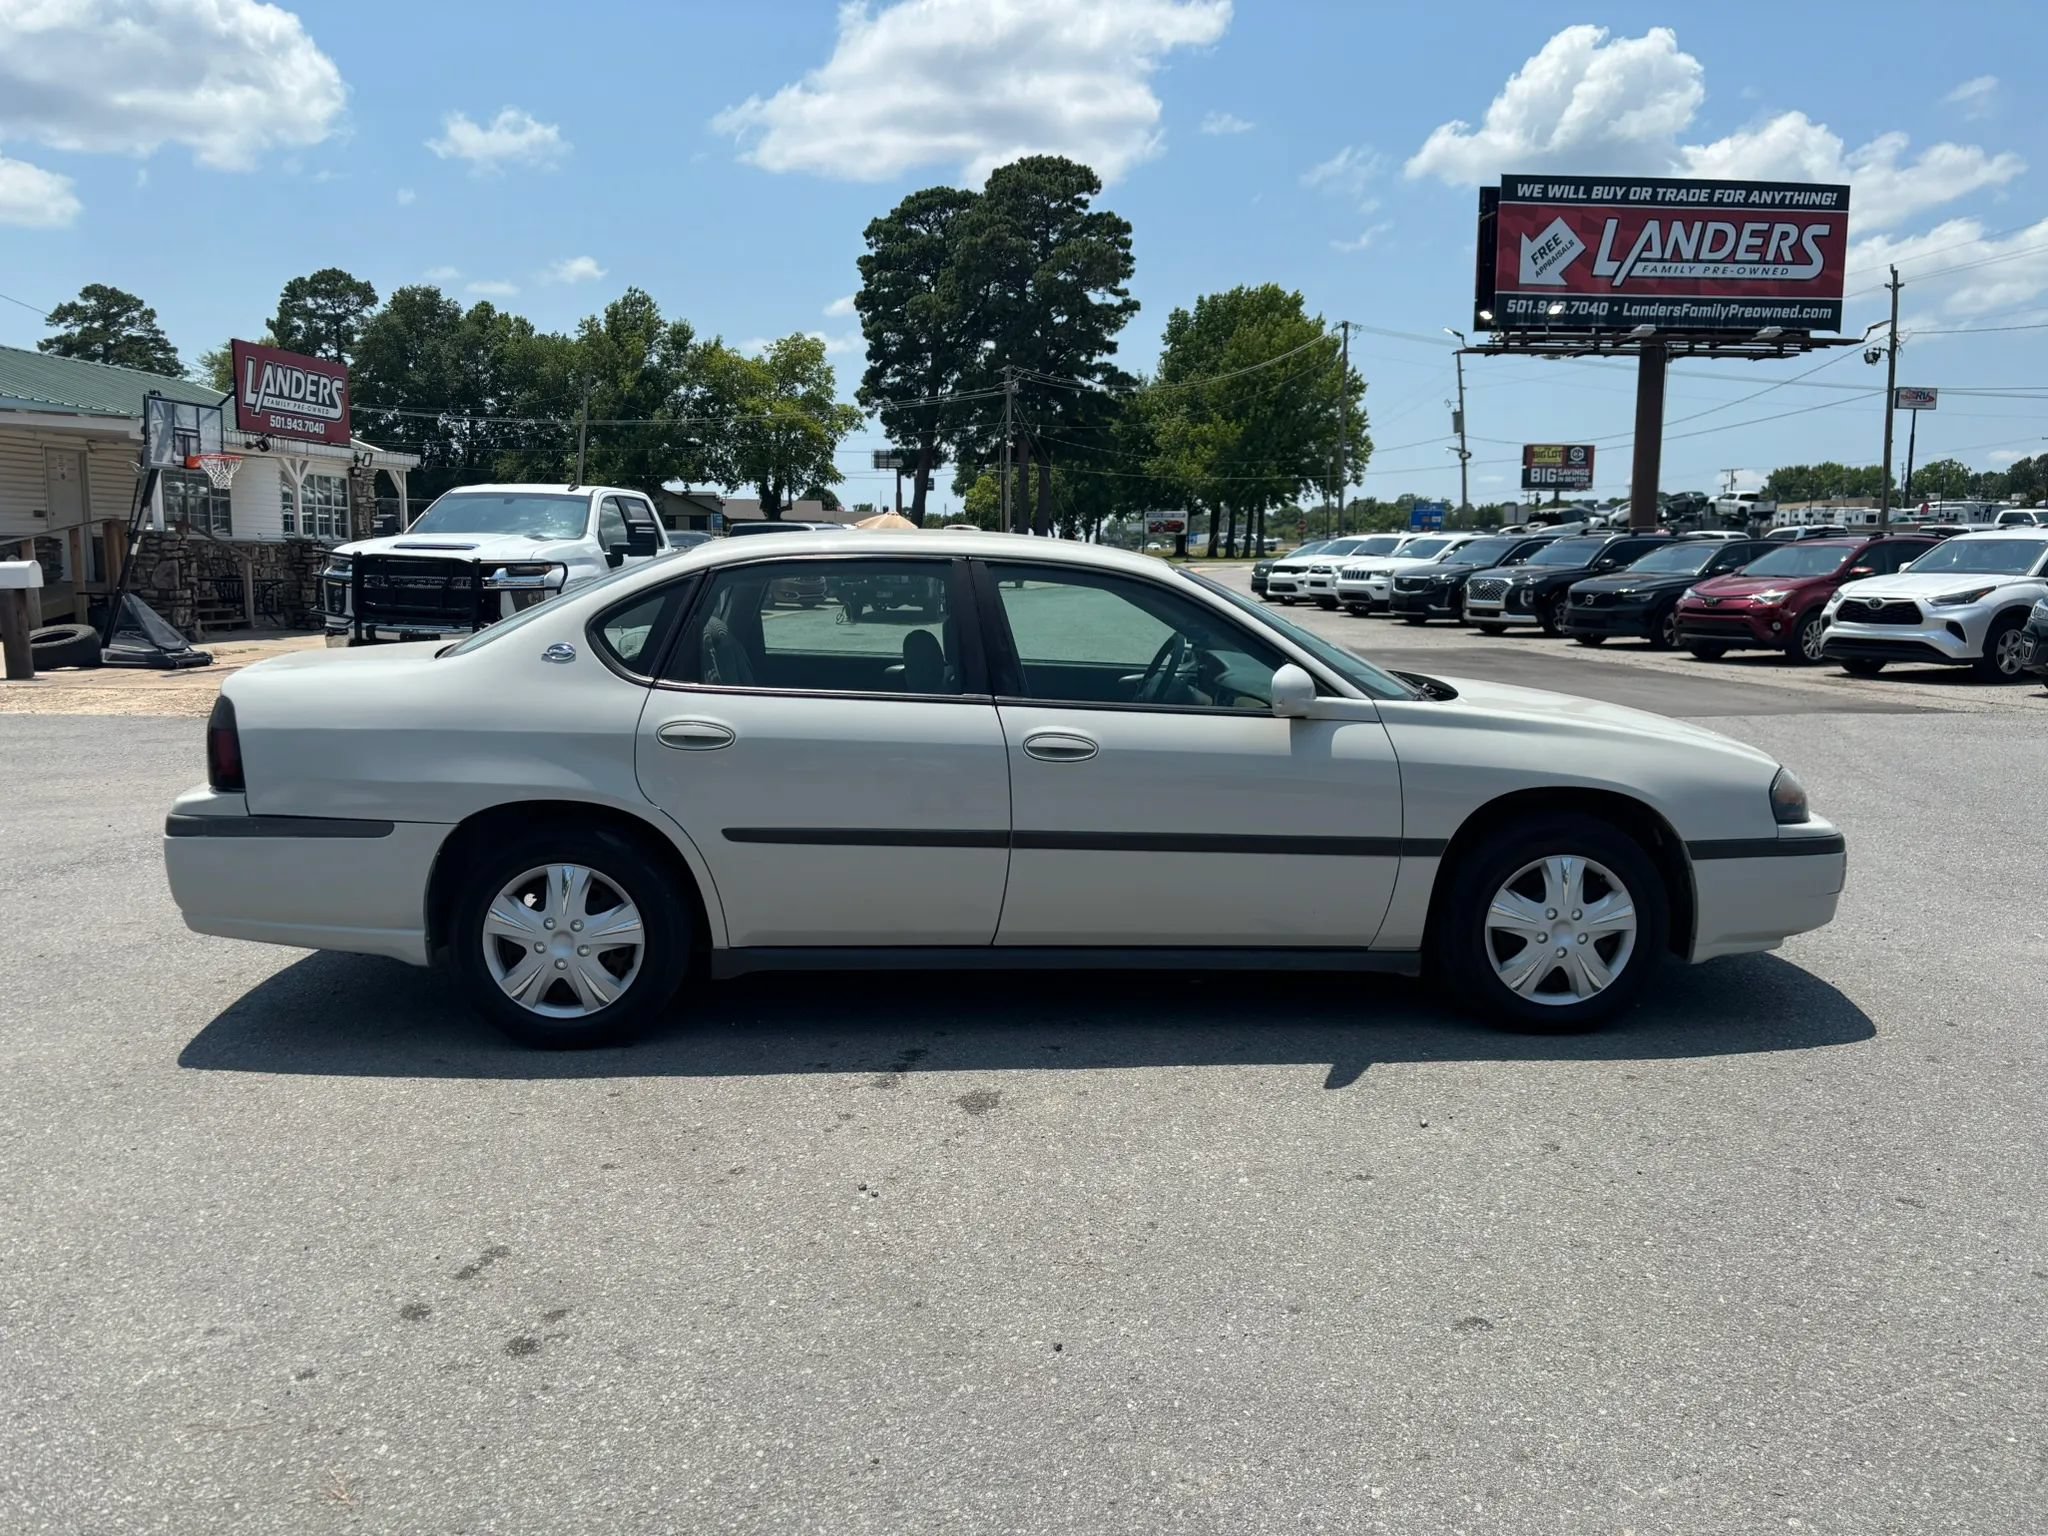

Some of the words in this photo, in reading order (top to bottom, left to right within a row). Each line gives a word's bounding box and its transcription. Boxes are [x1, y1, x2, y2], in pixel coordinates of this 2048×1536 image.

[1517, 183, 1544, 198] WE
[1547, 184, 1588, 199] WILL
[1591, 185, 1627, 200] BUY
[1628, 186, 1653, 201] OR
[1656, 188, 1711, 202] TRADE
[1713, 189, 1747, 203] FOR
[1747, 190, 1838, 206] ANYTHING!
[1530, 233, 1563, 266] FREE
[1535, 239, 1576, 278] APPRAISALS
[1591, 217, 1831, 287] LANDERS
[1641, 265, 1696, 274] FAMILY
[1702, 266, 1790, 276] PRE-OWNED
[1622, 302, 1833, 320] LandersFamilyPreowned.com
[243, 358, 344, 420] LANDERS
[266, 398, 290, 408] FAMILY
[293, 402, 330, 416] PRE-OWNED
[269, 415, 325, 435] 501.943.7040
[1530, 468, 1557, 483] BIG
[1557, 468, 1590, 476] SAVINGS
